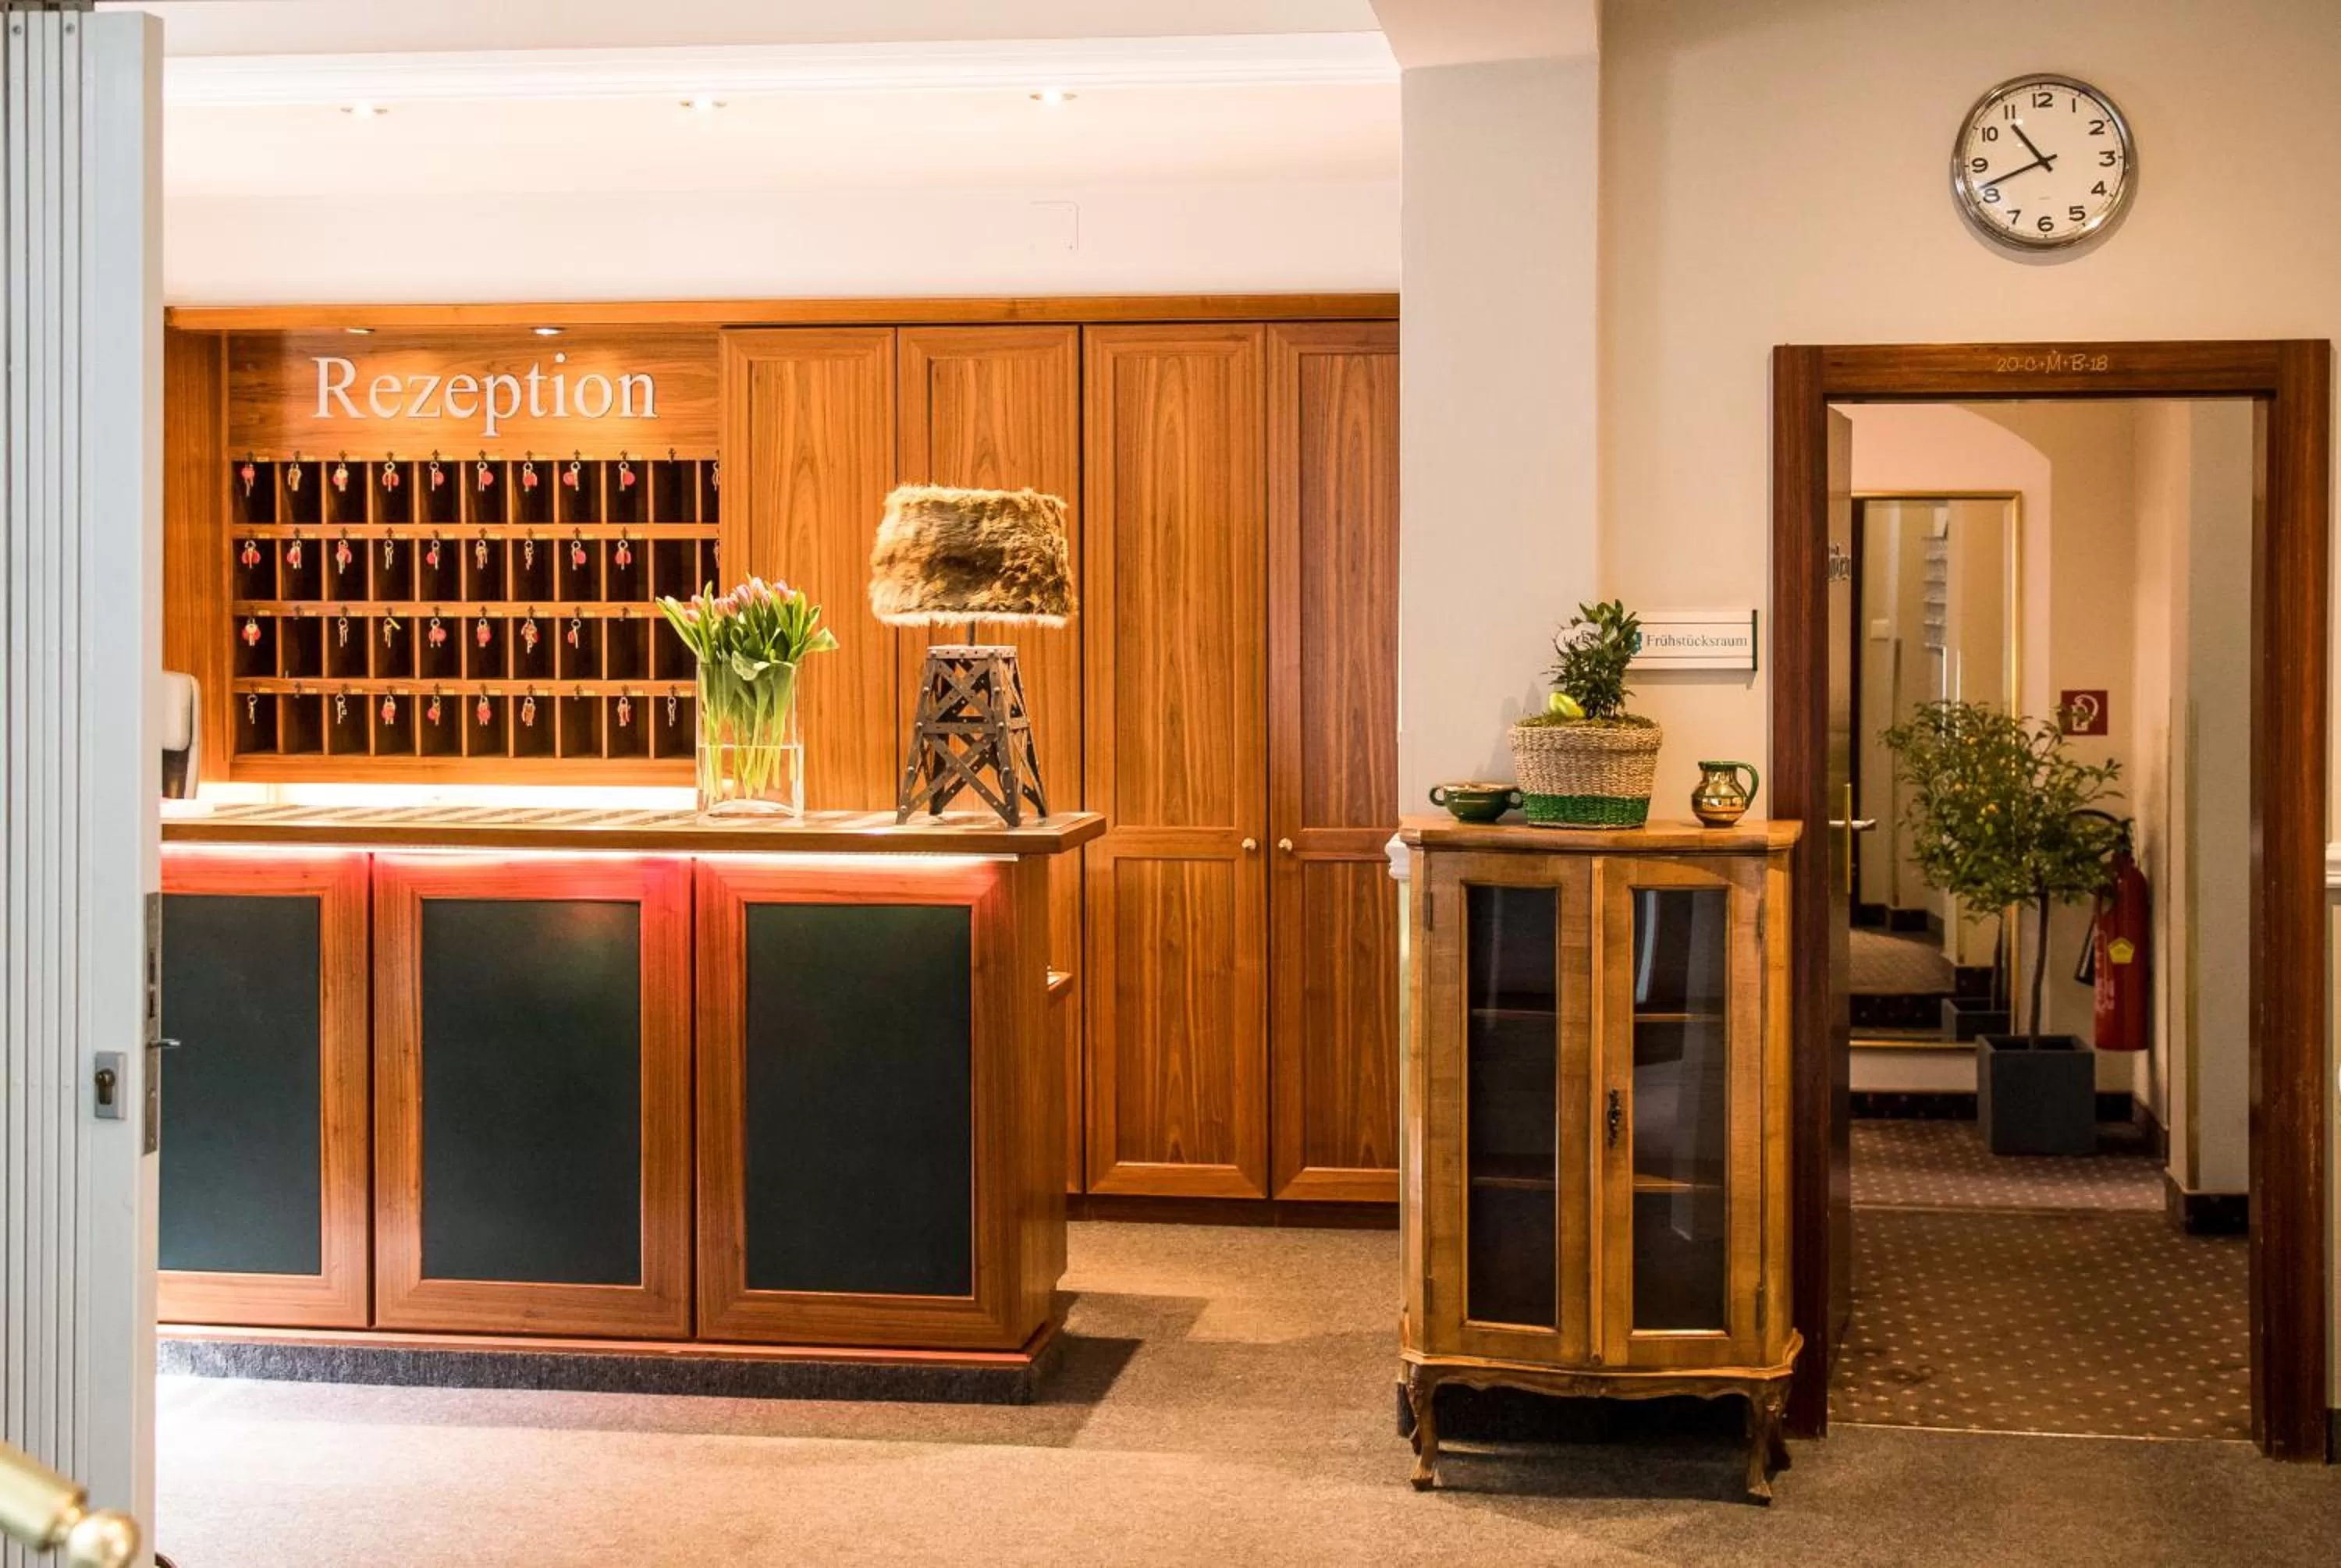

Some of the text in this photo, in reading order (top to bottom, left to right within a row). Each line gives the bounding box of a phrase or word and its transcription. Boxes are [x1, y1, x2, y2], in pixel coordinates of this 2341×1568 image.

[2032, 91, 2054, 108] 12
[2072, 98, 2076, 113] 1
[2004, 104, 2016, 120] 11
[1981, 126, 1998, 142] 10
[2089, 119, 2105, 136] 2
[1971, 158, 1989, 173] 9
[2099, 151, 2116, 166] 3
[1983, 188, 2002, 204] 8
[2091, 181, 2107, 196] 4
[2006, 209, 2022, 225] 7
[2069, 205, 2086, 221] 5
[2037, 216, 2055, 232] 6
[312, 351, 659, 437] Rezeption
[1647, 634, 1748, 647] Frühstücksraum
